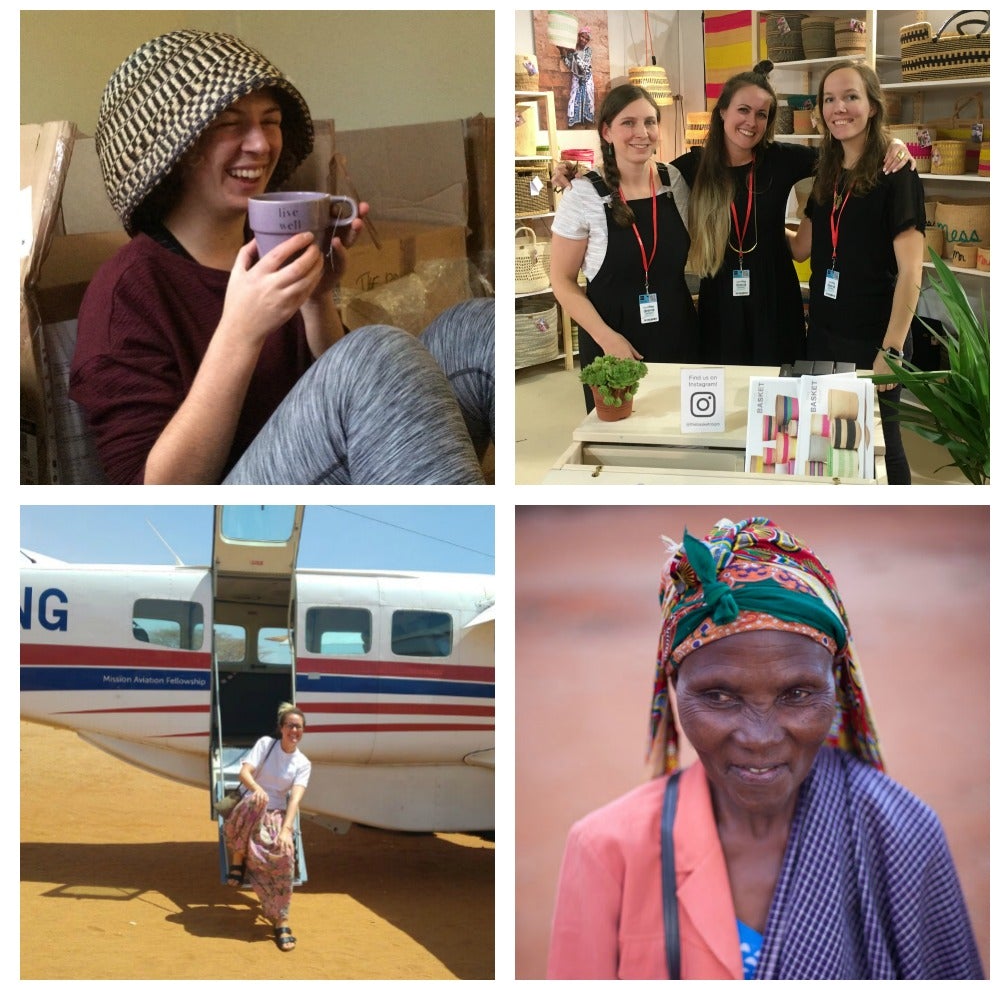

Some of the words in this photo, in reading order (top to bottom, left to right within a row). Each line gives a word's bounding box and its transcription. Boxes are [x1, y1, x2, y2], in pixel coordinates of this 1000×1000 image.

[278, 208, 299, 218] live
[280, 220, 302, 230] well
[756, 382, 765, 414] BASKET
[103, 675, 132, 683] Mission
[133, 676, 165, 684] Aviation
[166, 677, 207, 687] Fellowship
